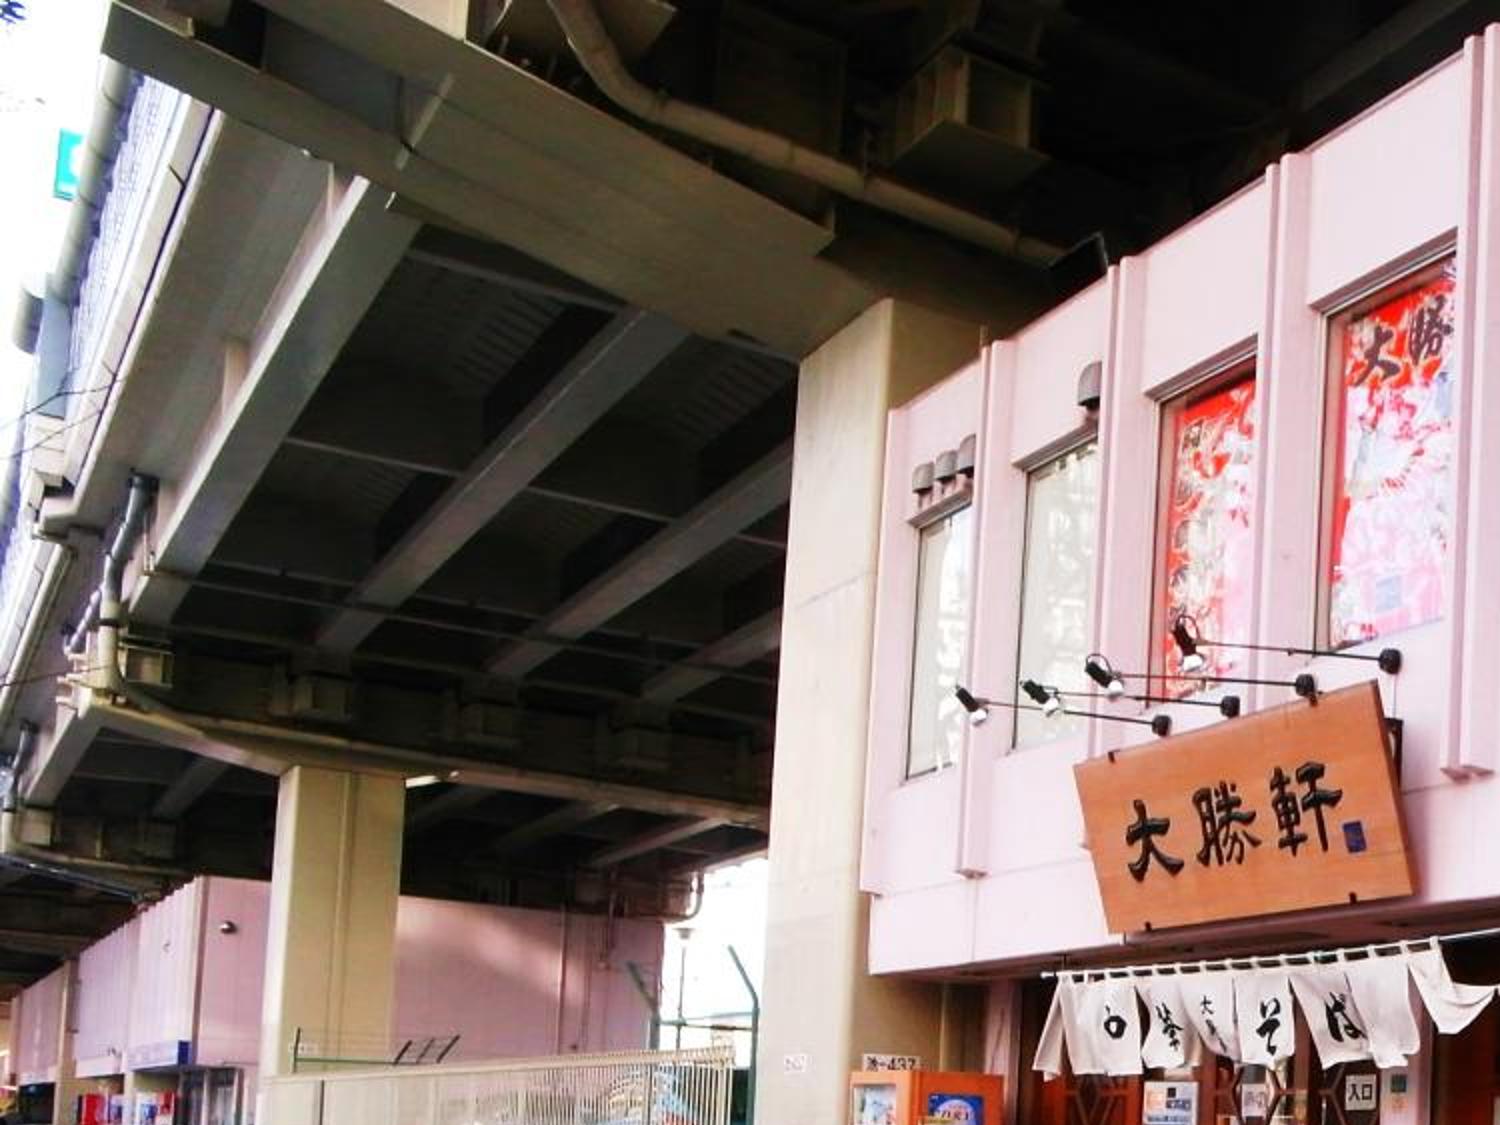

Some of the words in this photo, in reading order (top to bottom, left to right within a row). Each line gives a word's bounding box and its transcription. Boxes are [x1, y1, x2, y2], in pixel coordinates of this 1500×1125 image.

[1125, 761, 1342, 882] 大勝軒
[1349, 1083, 1372, 1101] 入口
